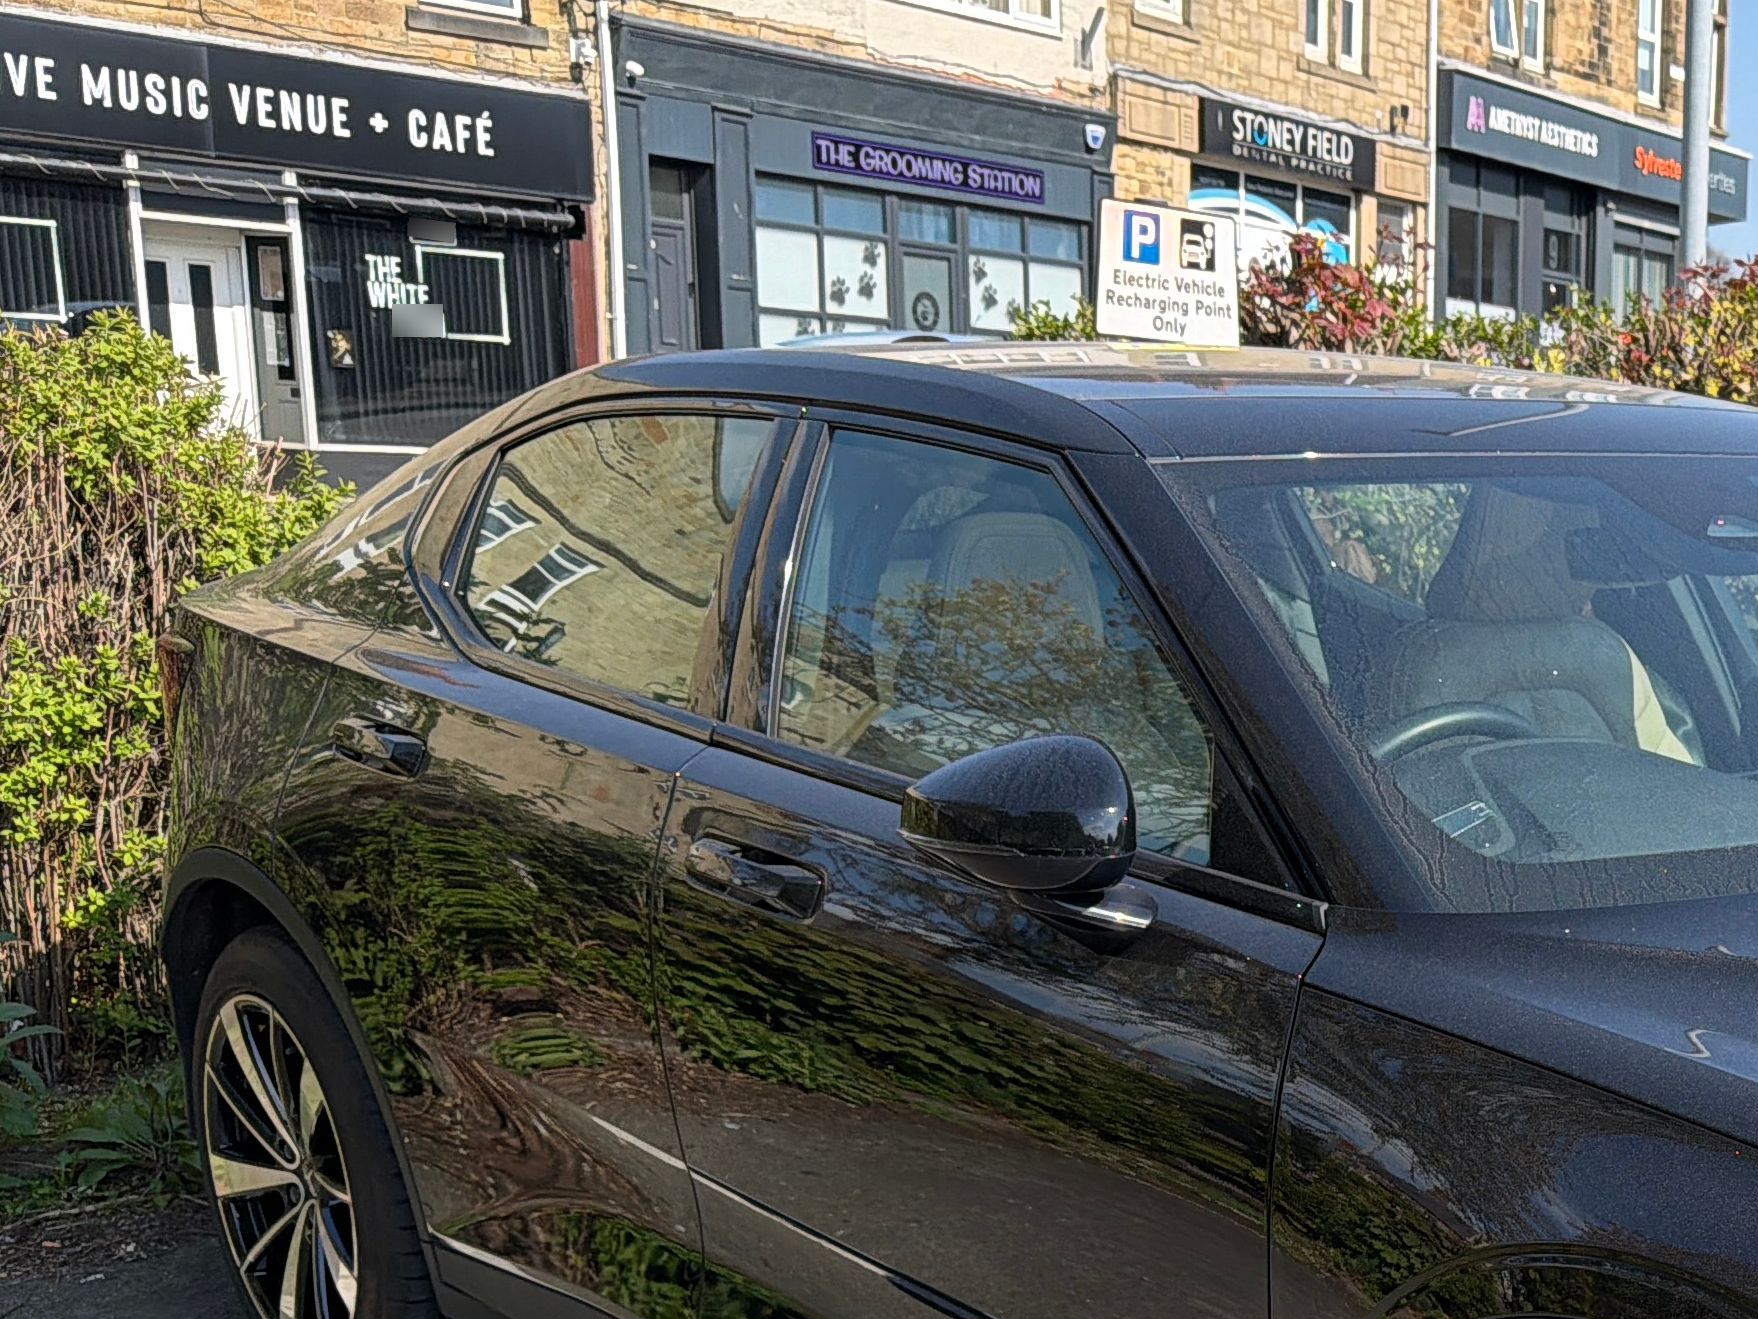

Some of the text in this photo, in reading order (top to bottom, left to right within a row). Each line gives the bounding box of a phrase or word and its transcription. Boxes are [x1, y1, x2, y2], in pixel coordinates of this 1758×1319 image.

[81, 63, 209, 120] MUSIC
[228, 83, 351, 138] VENUE
[369, 112, 389, 134] +
[408, 109, 495, 157] CAFÉ
[1232, 109, 1354, 165] STONEY FIELD
[1541, 119, 1599, 158] AESTHETICS
[815, 139, 1042, 198] THE GROOMING STATION
[1232, 144, 1353, 181] DENTAL PRACTICE
[365, 254, 402, 283] THE
[1113, 268, 1225, 298] Electric Vehicle
[1105, 288, 1232, 319] Recharging Point
[1152, 315, 1187, 337] Only
